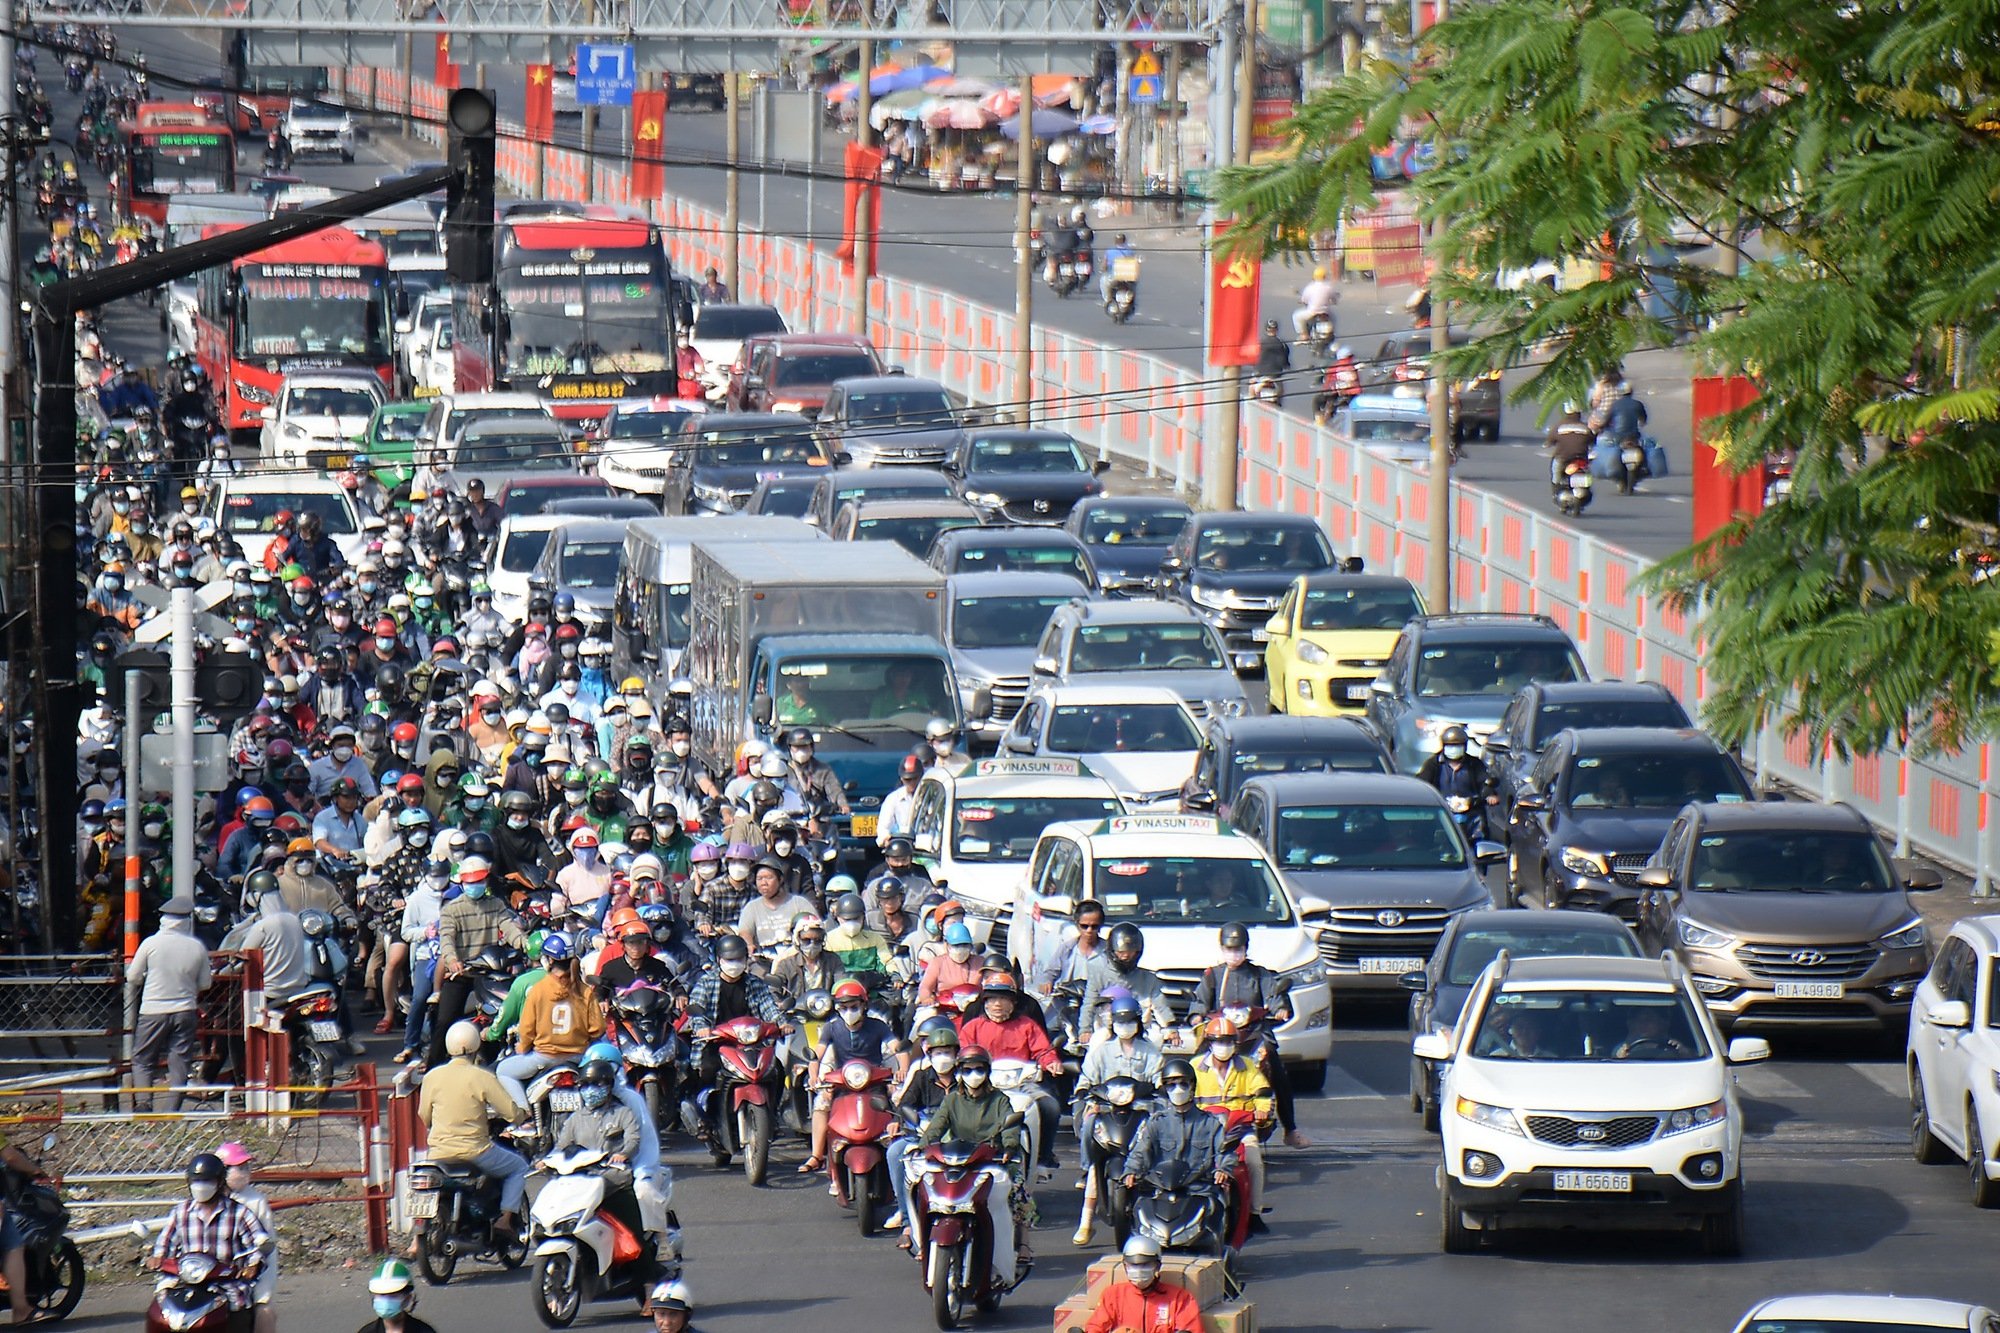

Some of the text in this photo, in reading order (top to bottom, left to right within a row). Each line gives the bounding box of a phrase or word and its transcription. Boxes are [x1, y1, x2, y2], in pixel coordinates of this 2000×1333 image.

[1001, 762, 1073, 773] VINASUN TAXI
[1134, 818, 1210, 829] VINASUN TAXI
[551, 1003, 571, 1035] 9
